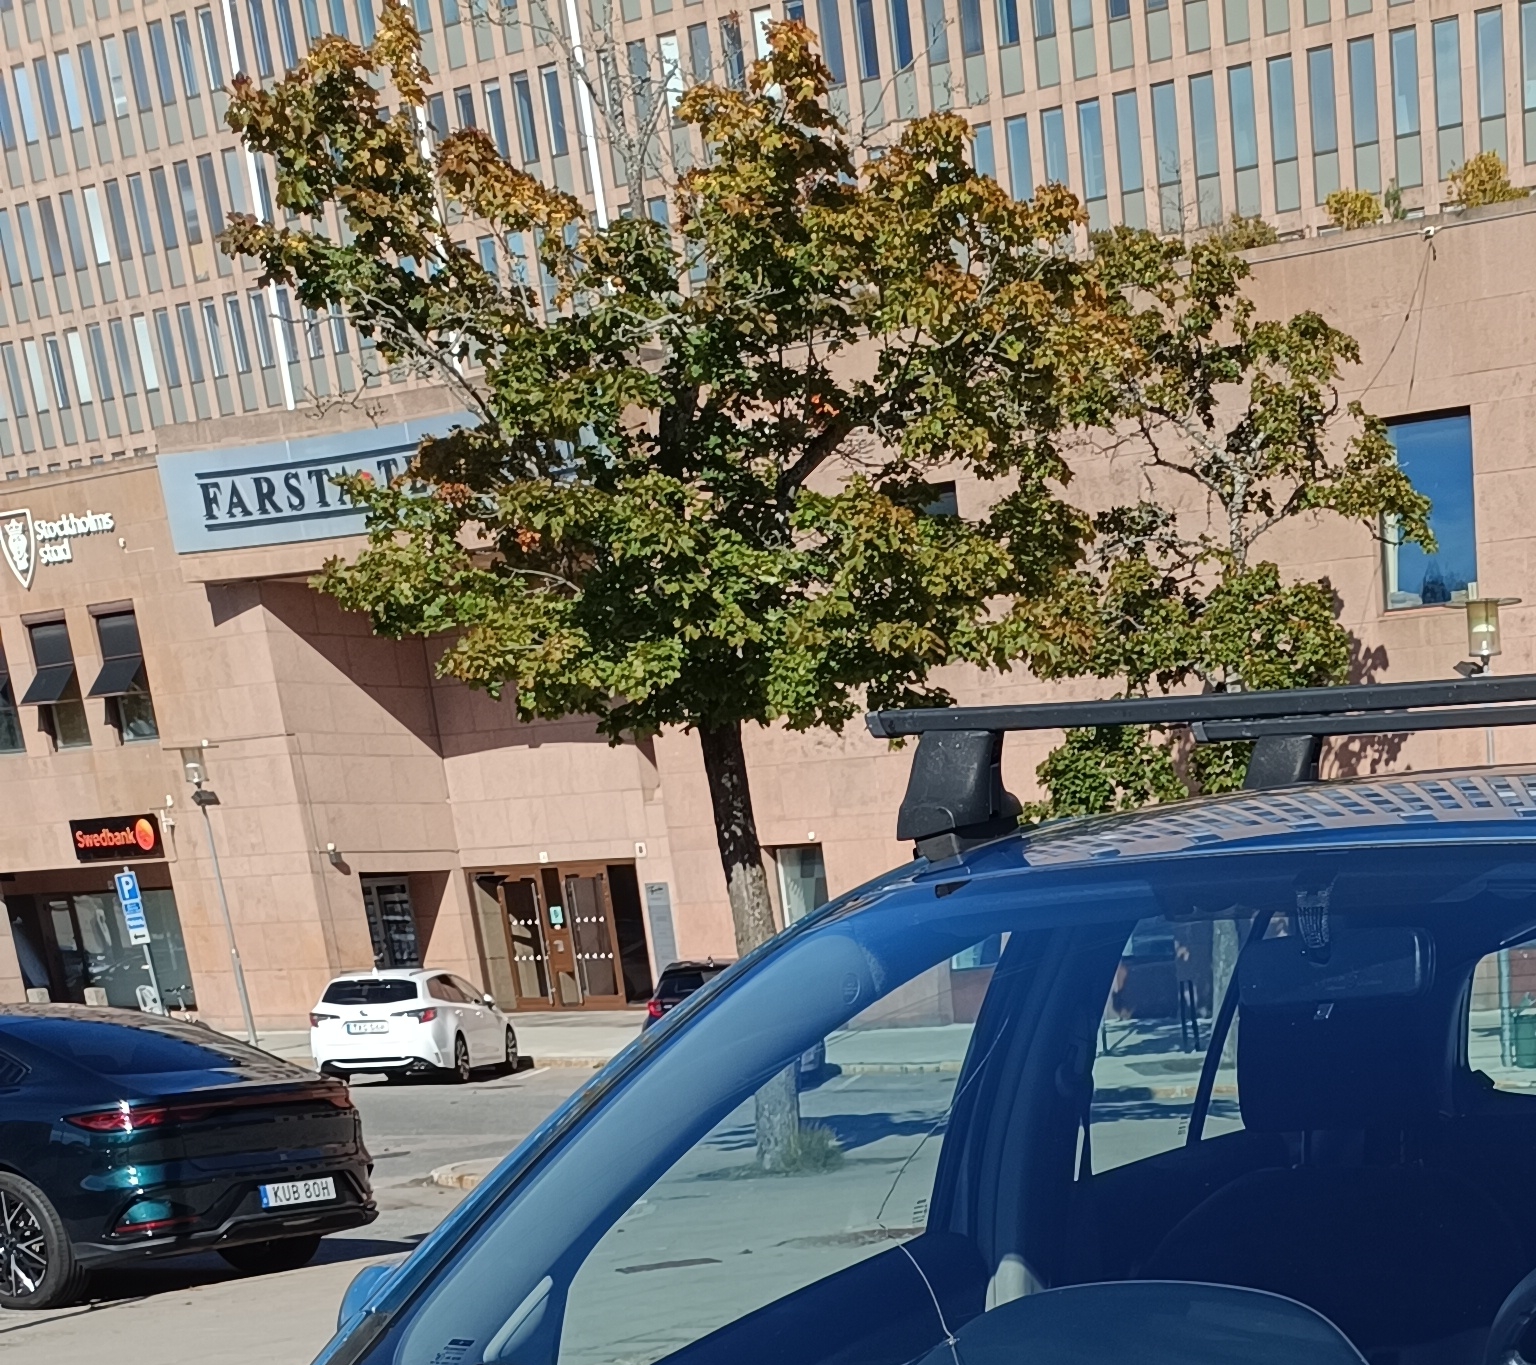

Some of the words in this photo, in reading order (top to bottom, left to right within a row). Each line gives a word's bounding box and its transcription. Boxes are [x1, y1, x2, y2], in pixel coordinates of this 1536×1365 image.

[33, 509, 115, 540] Stockholms
[39, 538, 72, 563] stad
[75, 826, 137, 848] Swedbank
[120, 876, 133, 899] P
[272, 1184, 300, 1203] KUB
